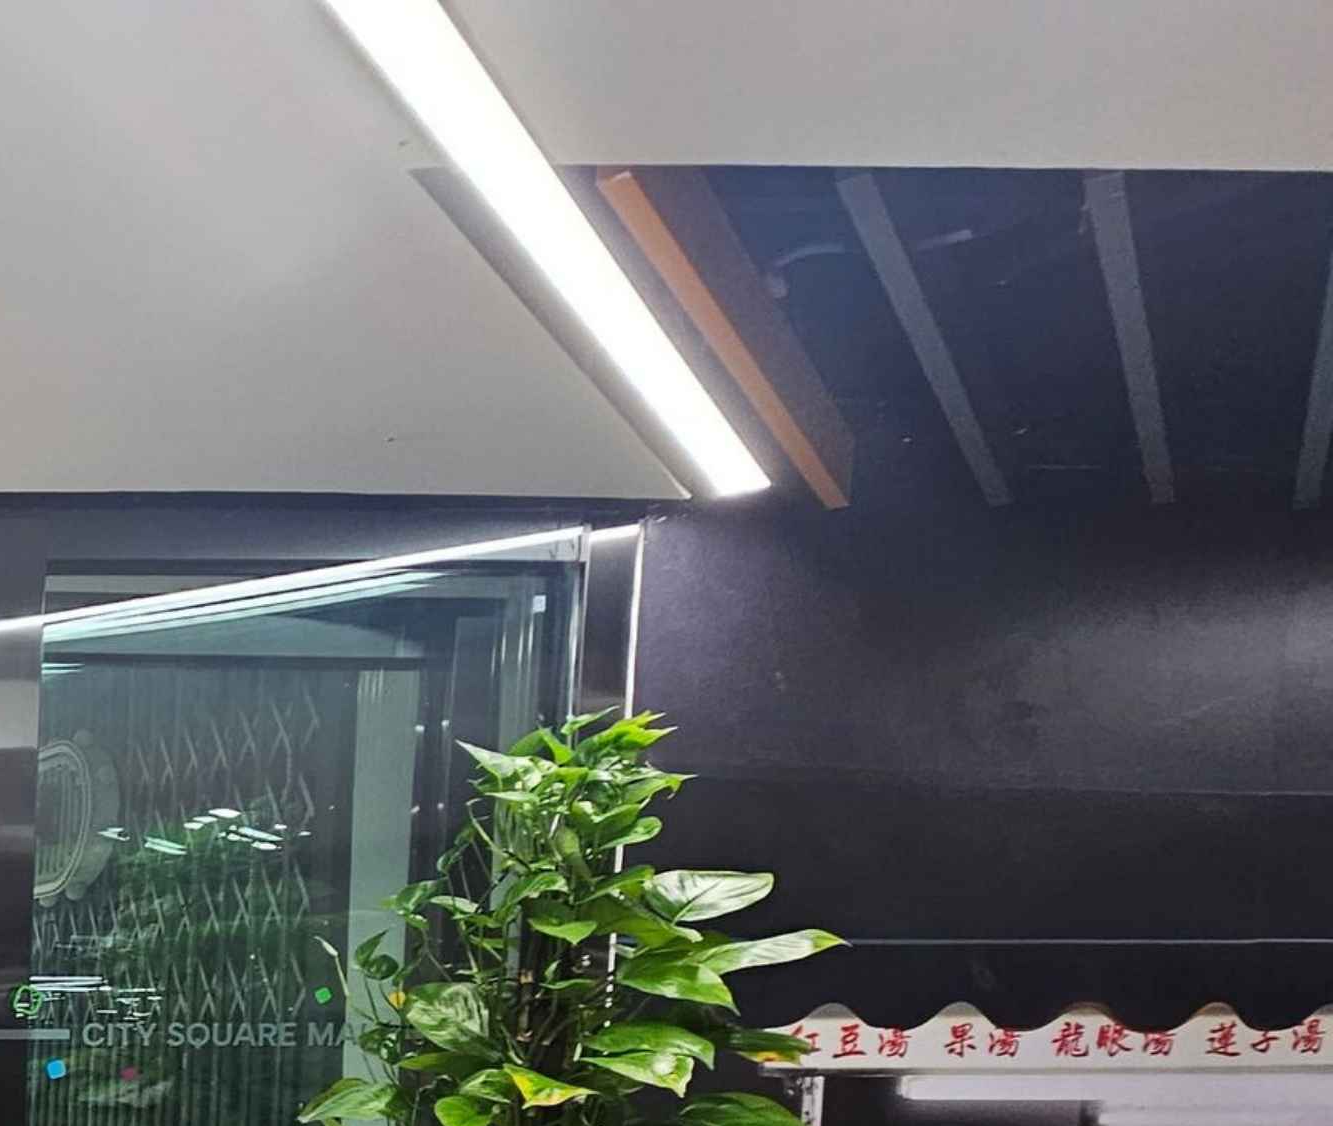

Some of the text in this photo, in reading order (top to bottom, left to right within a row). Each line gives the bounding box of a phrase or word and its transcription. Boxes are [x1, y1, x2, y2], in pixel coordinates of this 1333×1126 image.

[82, 1021, 367, 1048] CITY SQUARE MA
